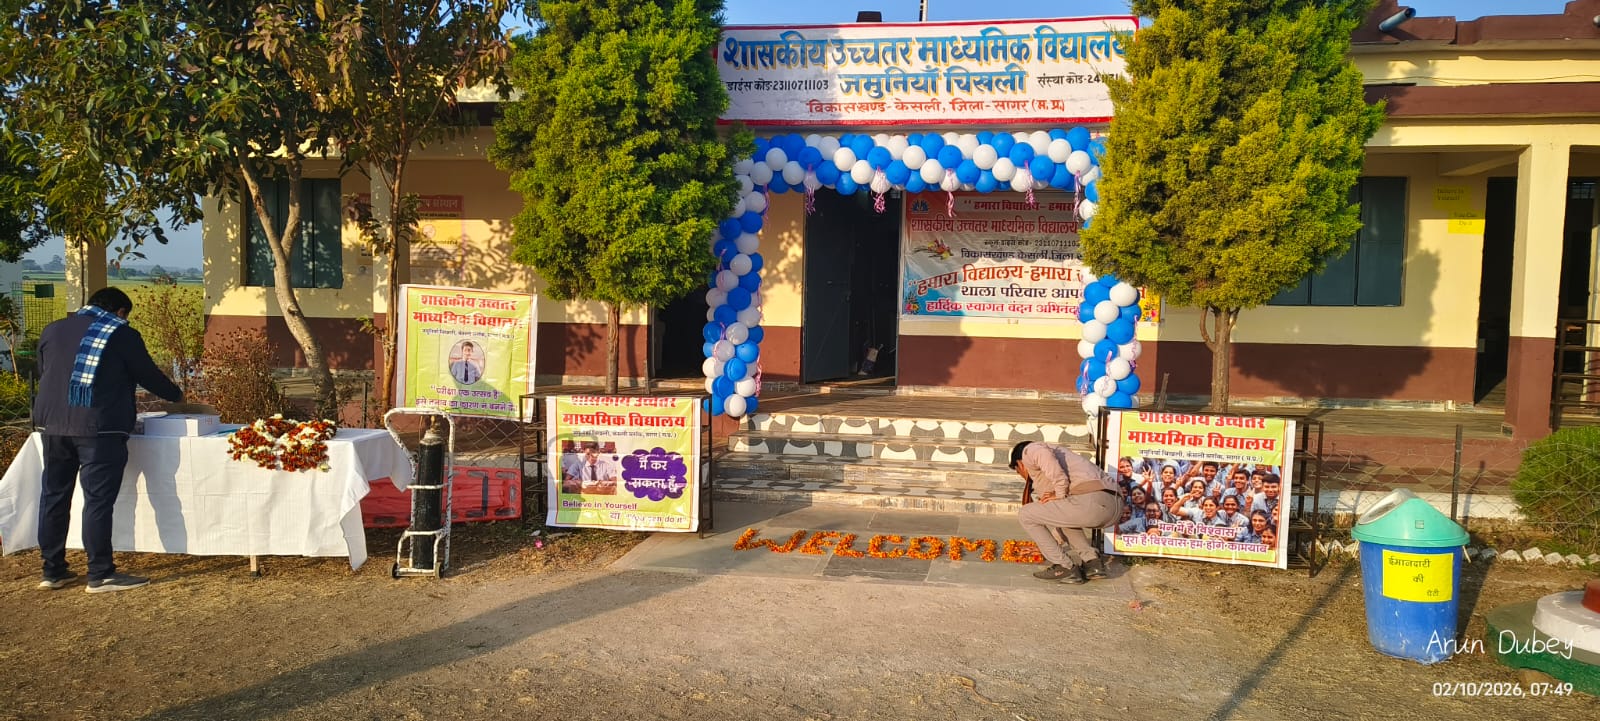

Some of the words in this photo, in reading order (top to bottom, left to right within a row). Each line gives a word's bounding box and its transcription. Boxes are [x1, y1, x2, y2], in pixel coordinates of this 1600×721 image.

[722, 31, 828, 69] शासकीय
[831, 37, 914, 68] उच्चतर
[917, 26, 1032, 66] माध्यमिक
[839, 64, 943, 99] जमुनियाँ
[944, 63, 1030, 95] चिखली
[993, 99, 1030, 113] सागर
[911, 214, 954, 232] शासकीय
[957, 219, 989, 233] उच्चतर
[991, 215, 1035, 233] माध्यमिक
[1038, 215, 1079, 234] विद्यालय
[961, 285, 996, 297] शाला
[1000, 284, 1047, 298] परिवार
[1051, 286, 1085, 299] आप
[421, 294, 476, 308] शासकीय
[926, 297, 962, 312] हार्दिक
[966, 303, 1004, 313] स्वागत
[1007, 301, 1033, 314] वंदन
[1036, 300, 1080, 315] अभिनंद
[413, 311, 471, 325] माध्यमिक
[563, 412, 626, 427] माध्यमिक
[628, 413, 686, 428] विद्यालय
[1215, 416, 1266, 429] उच्चतर
[1128, 430, 1204, 447] माध्यमिक
[1207, 432, 1276, 451] विद्यालय
[650, 460, 668, 471] कर
[631, 477, 666, 489] सकता
[563, 501, 592, 509] Believe
[605, 502, 638, 510] Yourself
[610, 512, 621, 520] या
[733, 528, 1044, 563] WELCOME
[1123, 536, 1138, 547] पूरा
[1227, 542, 1269, 553] कामयाब
[1412, 573, 1425, 584] की
